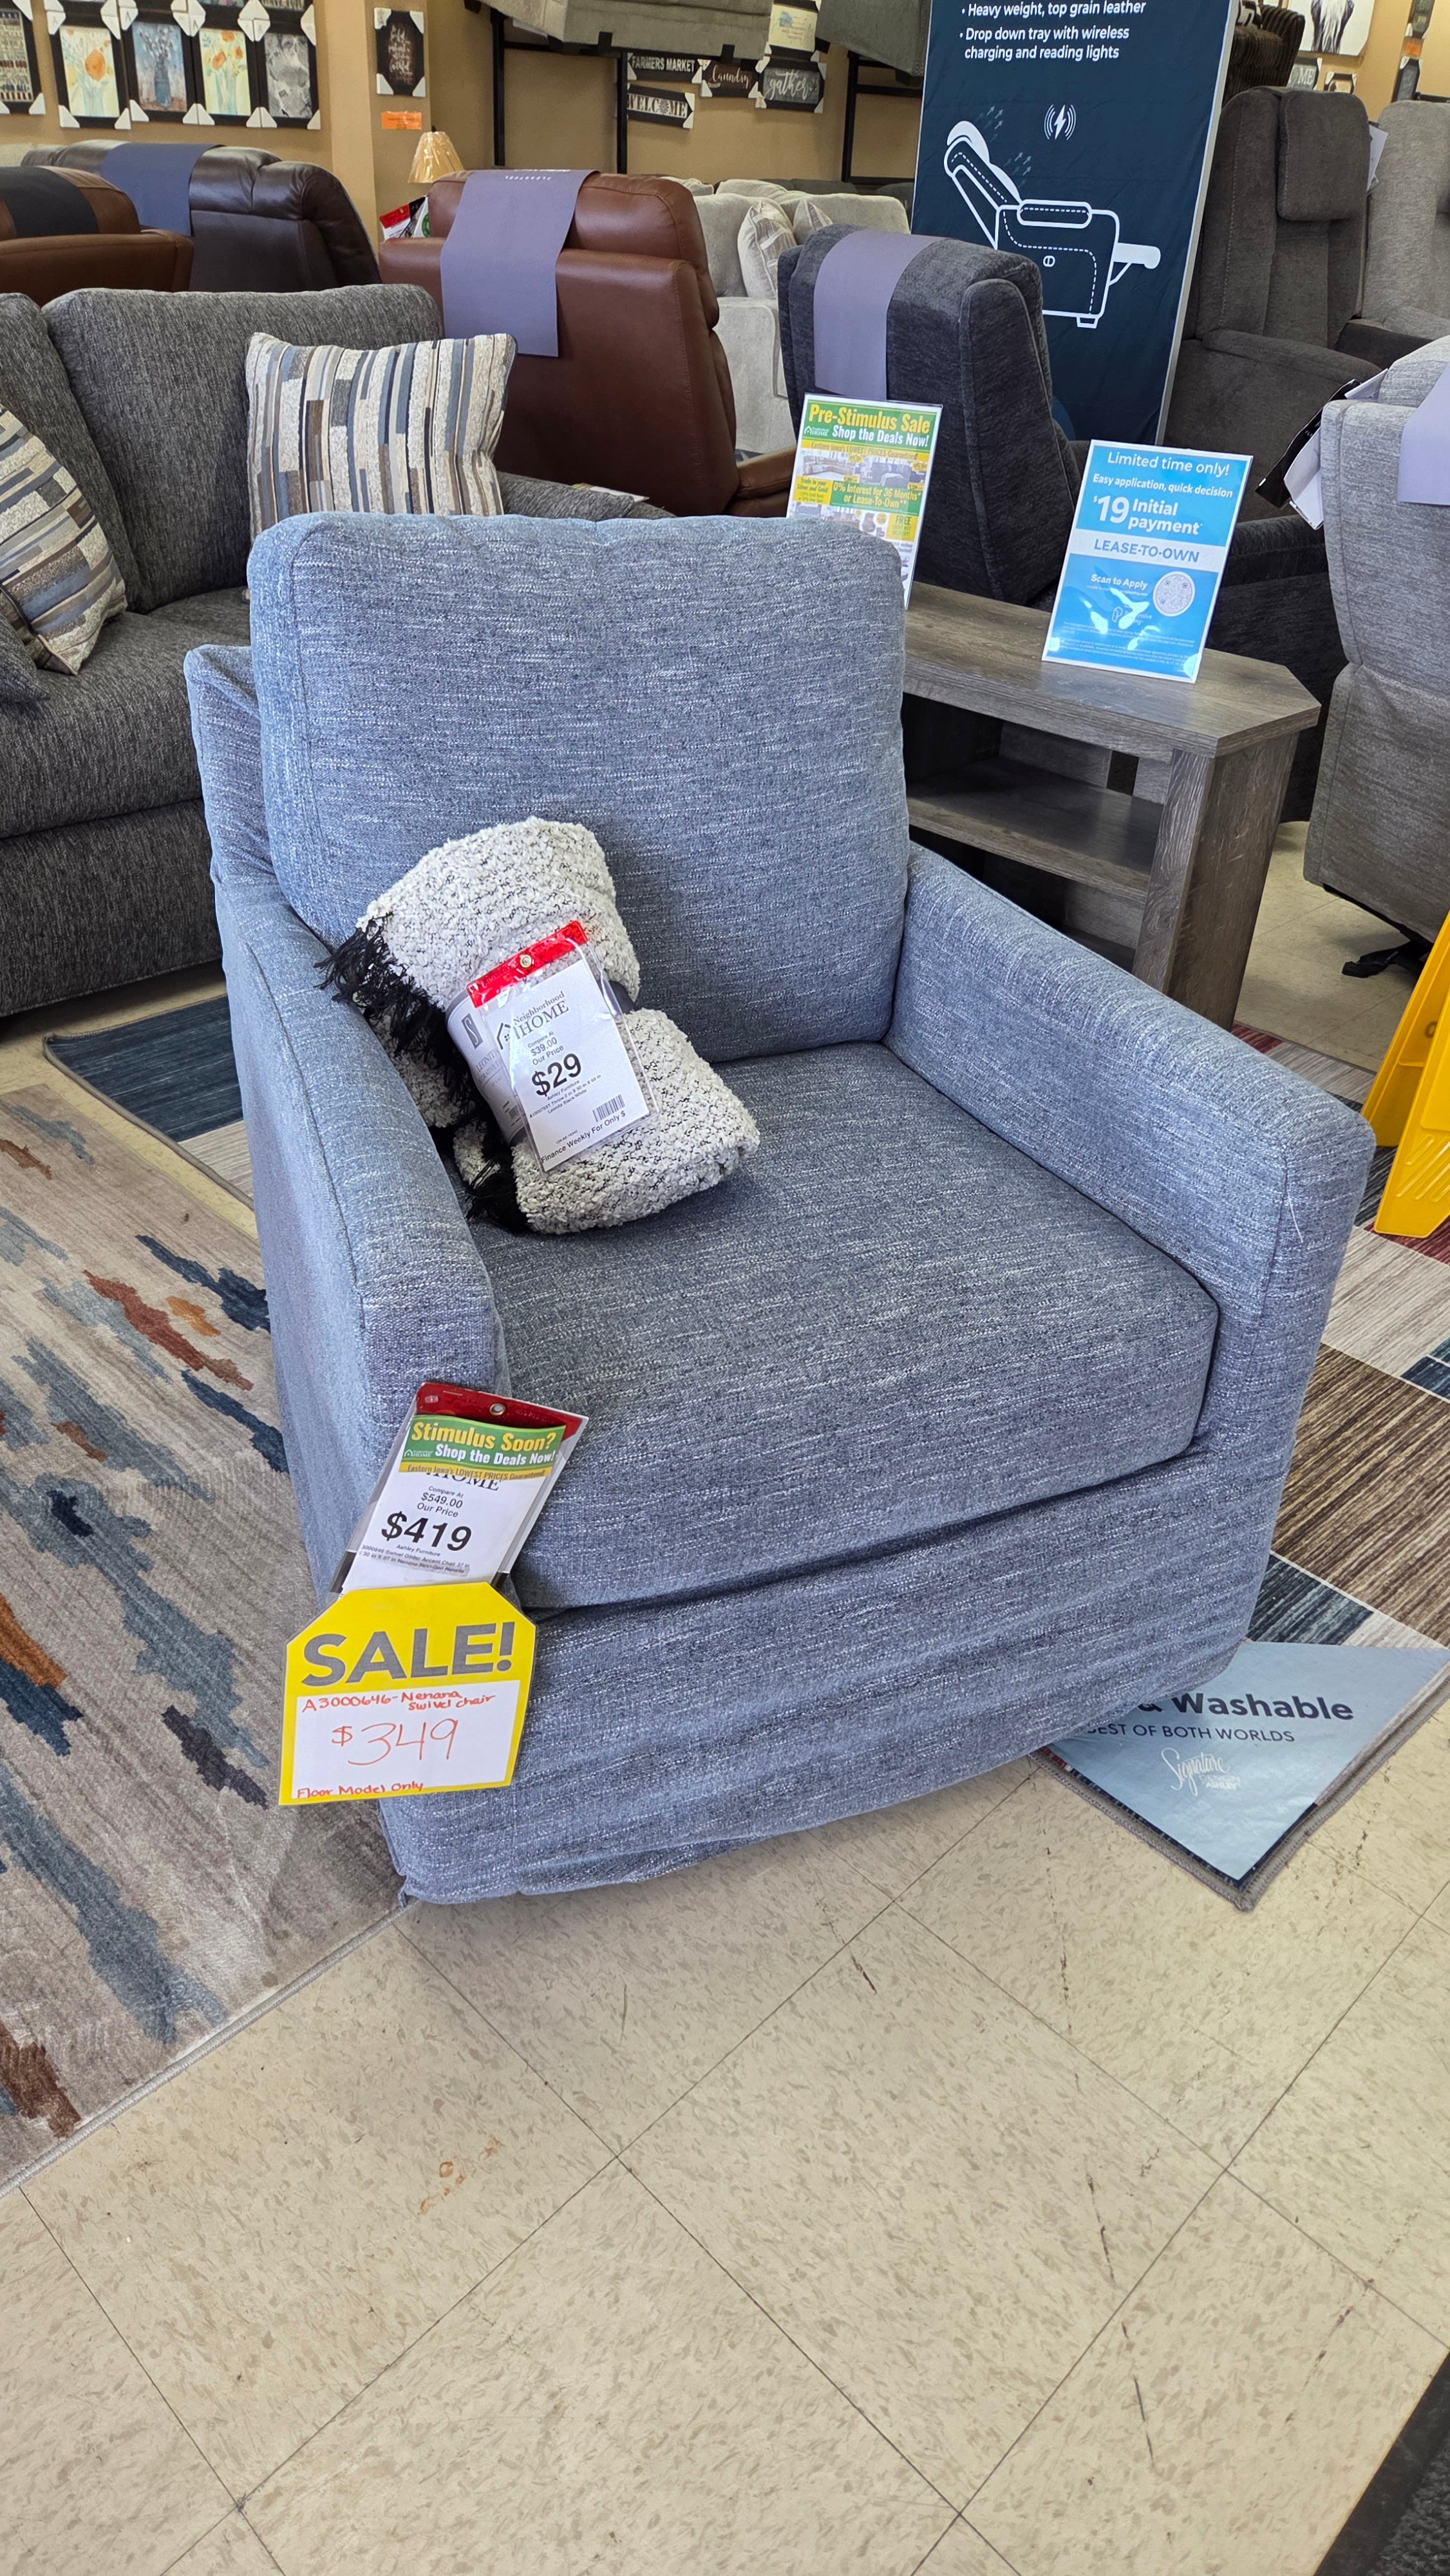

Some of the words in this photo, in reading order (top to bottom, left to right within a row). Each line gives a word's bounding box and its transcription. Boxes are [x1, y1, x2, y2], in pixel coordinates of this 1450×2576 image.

[968, 3, 1001, 19] Heavy
[1003, 1, 1045, 19] weight,
[1047, 3, 1067, 17] top
[1069, 0, 1100, 17] grain
[1103, 0, 1146, 14] leather
[965, 28, 992, 43] Drop
[995, 27, 1025, 40] down
[1028, 28, 1051, 43] tray
[1053, 26, 1078, 40] with
[1082, 25, 1130, 39] wireless
[632, 55, 665, 70] FARMERS
[666, 58, 695, 72] MARKET
[965, 46, 1013, 62] charging
[1015, 46, 1037, 59] and
[1039, 45, 1084, 62] reading
[1086, 44, 1120, 61] lights
[763, 69, 809, 100] gather
[809, 404, 898, 430] Pre-Stimulus
[901, 413, 931, 434] Sale
[832, 424, 857, 442] Shop
[859, 428, 874, 441] the
[877, 430, 903, 444] Deals
[905, 433, 929, 447] Now!
[1107, 451, 1159, 468] Limited
[1162, 457, 1192, 472] time
[1196, 462, 1230, 478] only!
[833, 482, 845, 493] 0%
[847, 484, 872, 495] Interest
[873, 486, 883, 497] for
[883, 488, 893, 498] 36
[1093, 473, 1113, 486] Easy
[1115, 477, 1167, 492] application,
[1168, 483, 1193, 494] quick
[1194, 485, 1233, 498] decision
[1093, 495, 1130, 524] $19
[1132, 498, 1178, 516] Initial
[1094, 538, 1200, 562] LEASE-TO-OWN
[1091, 574, 1111, 583] Scan
[1122, 578, 1149, 591] Apply
[513, 990, 565, 1025] Neighborhood
[518, 1000, 569, 1037] HOME
[527, 1035, 548, 1048] Compare
[531, 1037, 558, 1057] $39.00
[532, 1055, 546, 1066] Our
[546, 1045, 564, 1058] Price
[531, 1052, 581, 1097] $29
[541, 1145, 567, 1164] Finance
[567, 1131, 590, 1148] Weekly
[591, 1124, 603, 1134] For
[604, 1114, 620, 1126] Only
[411, 1421, 496, 1449] Stimulus
[501, 1432, 557, 1452] Soon?
[435, 1444, 466, 1461] Shop
[470, 1449, 490, 1464] the
[493, 1452, 527, 1465] Deals
[529, 1450, 556, 1465] Now!
[408, 1464, 432, 1473] Eastern
[433, 1466, 454, 1475] Iowa's
[455, 1468, 484, 1479] LOWEST
[484, 1471, 509, 1480] PRICES
[421, 1492, 463, 1508] $549.00
[428, 1486, 456, 1496] Compare
[417, 1502, 434, 1511] Our
[435, 1506, 458, 1517] Price
[381, 1511, 472, 1551] $419
[415, 1548, 441, 1557] Furniture
[301, 1622, 516, 1687] SALE!
[1171, 1692, 1355, 1720] Washable
[331, 1718, 458, 1765] $349
[1132, 1724, 1157, 1736] OF
[1162, 1726, 1212, 1739] BOTH
[1216, 1728, 1295, 1743] WORLDS
[1161, 1747, 1230, 1797] Signature
[297, 1787, 334, 1799] Floor
[338, 1785, 386, 1795] Model
[391, 1781, 424, 1792] Only
